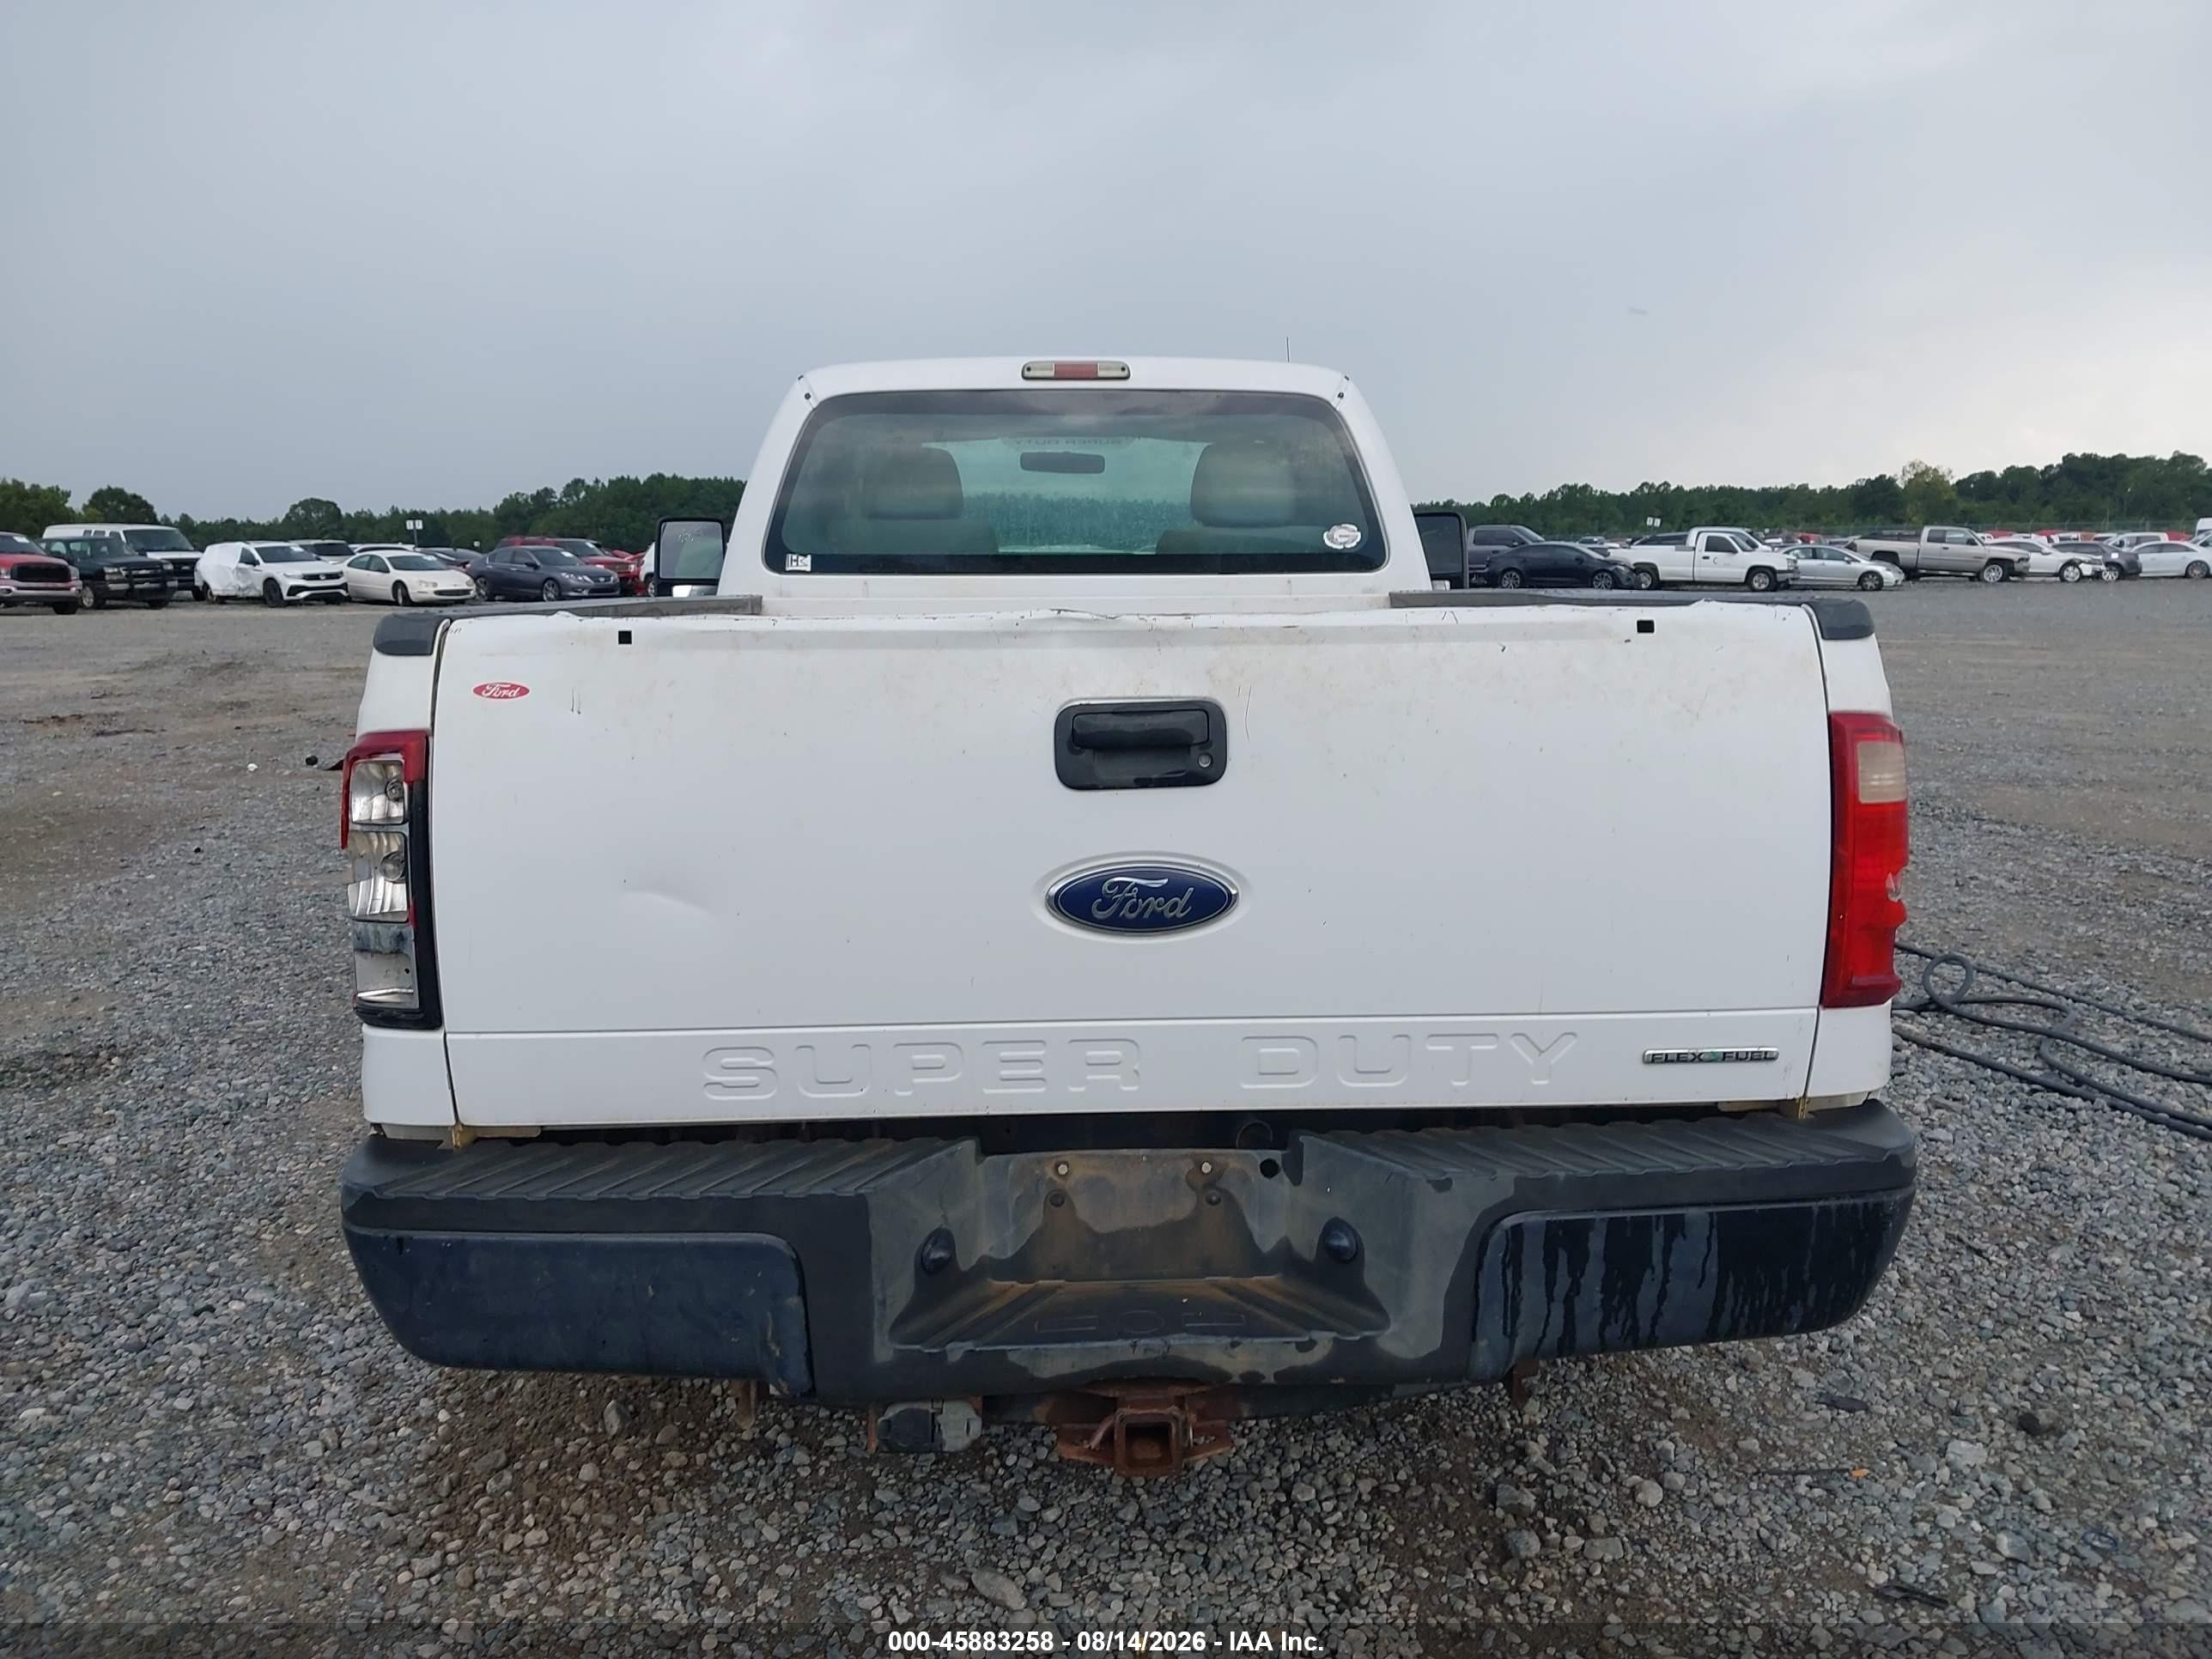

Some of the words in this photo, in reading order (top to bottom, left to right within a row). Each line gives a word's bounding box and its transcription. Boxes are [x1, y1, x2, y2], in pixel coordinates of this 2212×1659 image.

[482, 684, 521, 697] Ford
[1091, 877, 1194, 920] Ford
[702, 1039, 1141, 1100] SUPER
[1241, 1032, 1577, 1089] DUTY
[1650, 1052, 1704, 1063] FLEX
[1722, 1050, 1777, 1061] FUEL
